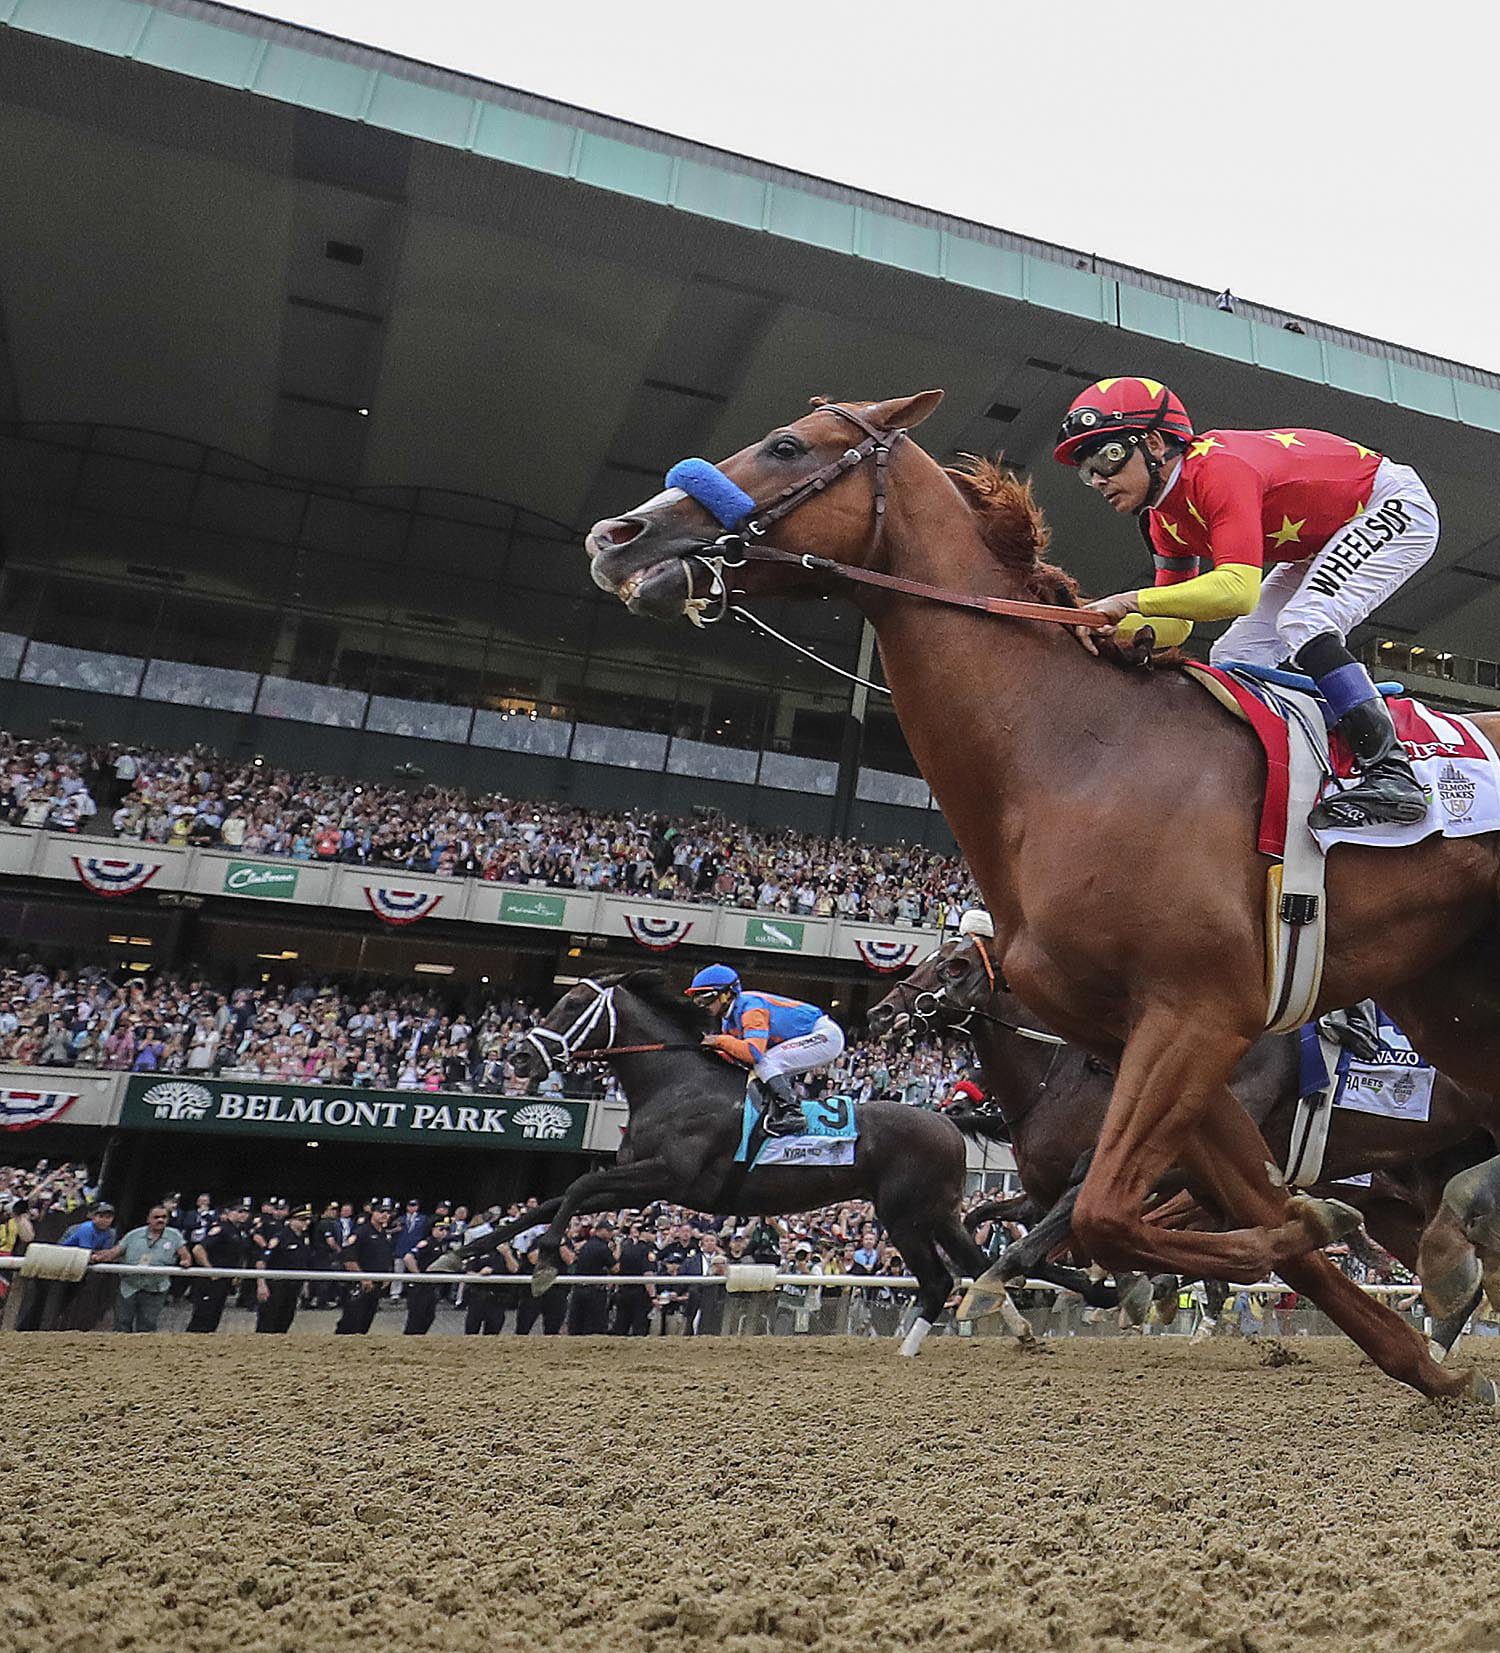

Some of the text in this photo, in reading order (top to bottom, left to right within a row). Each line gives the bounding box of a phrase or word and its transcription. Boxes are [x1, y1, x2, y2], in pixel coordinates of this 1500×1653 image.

[1440, 791, 1475, 801] STAKES
[1368, 1050, 1419, 1066] VAZO
[1361, 1076, 1384, 1089] BETS
[216, 1093, 406, 1127] BELMONT
[409, 1104, 508, 1133] PARK
[818, 1096, 848, 1129] 9
